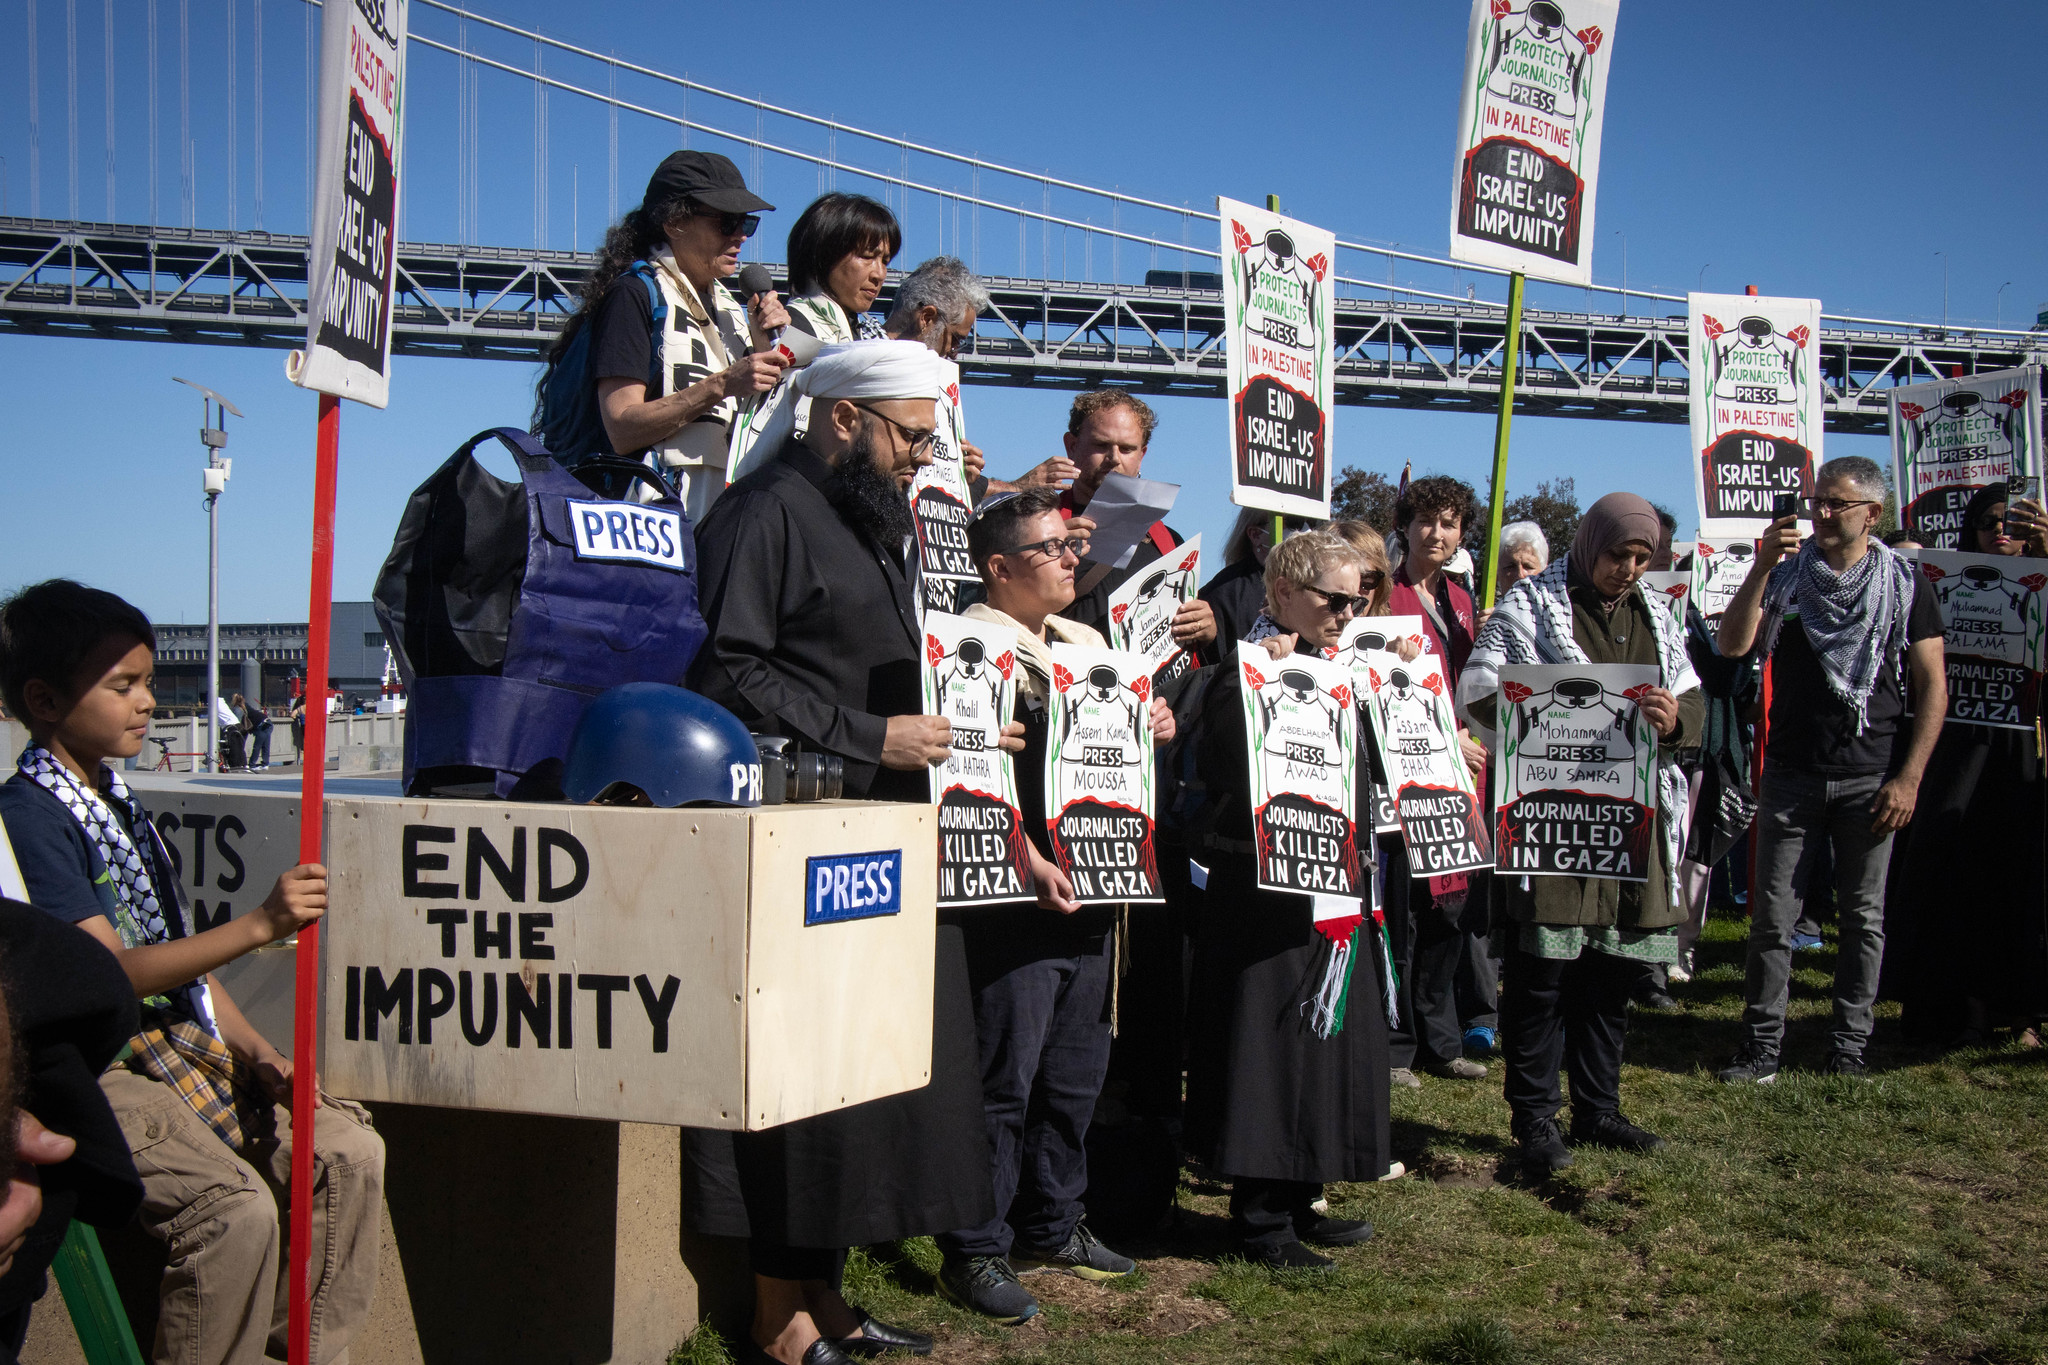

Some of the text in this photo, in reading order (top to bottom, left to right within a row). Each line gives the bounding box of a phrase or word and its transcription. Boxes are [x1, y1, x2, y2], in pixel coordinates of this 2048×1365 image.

[1513, 38, 1565, 69] PROTECT
[350, 24, 394, 117] PALESTINE
[1501, 58, 1570, 94] JOURNALISTS
[1510, 85, 1554, 113] PRESS
[1486, 105, 1571, 149] IN PALESTINE
[349, 120, 375, 196] END
[1506, 149, 1544, 183] END
[1476, 172, 1567, 221] ISRAEL-US
[337, 194, 387, 280] RAEL-US
[1474, 203, 1565, 252] IMPUNITY
[1259, 270, 1299, 301] PROTECT
[324, 265, 383, 349] MPUNITY
[1252, 293, 1308, 325] JOURNALISTS
[1264, 319, 1297, 346] PRESS
[1248, 344, 1312, 381] IN PALESTINE
[1732, 351, 1779, 368] PROTECT
[1723, 368, 1789, 385] JOURNALISTS
[1268, 388, 1295, 421] END
[1736, 387, 1777, 403] PRESS
[1718, 408, 1796, 428] IN PALESTINE
[1936, 417, 1990, 434] PROTECT
[1248, 416, 1314, 457] ISRAEL-US
[1925, 430, 2001, 449] JOURNALISTS
[1742, 440, 1775, 462] END
[1940, 447, 1987, 463] PRESS
[1249, 449, 1314, 489] IMPUNITY
[1717, 464, 1800, 488] ISRAEL-US
[1919, 462, 2011, 485] IN PALESTINE
[918, 498, 968, 525] JOURNALISTS
[1719, 489, 1801, 512] IMPUN
[1946, 490, 1977, 509] EN
[1918, 510, 1966, 532] ISRAE
[581, 510, 675, 559] PRESS
[925, 521, 969, 549] KILLED
[925, 547, 978, 575] IN GAZ
[1138, 605, 1162, 636] Jamal
[1954, 619, 2000, 634] PRESS
[1142, 617, 1169, 652] PRESS
[1943, 632, 2008, 653] SALAMA
[951, 682, 966, 693] NAME
[1949, 679, 2014, 701] ILLED
[955, 698, 978, 719] Khalil
[1083, 706, 1100, 716] NAME
[1281, 704, 1298, 714] NAME
[1955, 699, 2019, 723] GAZA
[1073, 722, 1102, 744] Assem
[1278, 725, 1331, 741] ABDELHALIM
[1394, 715, 1430, 734] Issam
[1539, 720, 1611, 742] Mohammad
[953, 728, 984, 750] PRESS
[1400, 740, 1430, 754] PRESS
[947, 755, 960, 775] ABU
[1083, 748, 1122, 766] PRESS
[1287, 743, 1324, 765] PRESS
[1548, 747, 1604, 761] PRESS
[1284, 762, 1328, 781] AWAD
[1400, 756, 1434, 777] BHAR
[1526, 764, 1621, 785] ABU SAMRA
[1073, 770, 1127, 791] MOUSSA
[940, 806, 1008, 830] JOURNALISTS
[1400, 795, 1466, 818] JOURNALISTS
[1513, 801, 1635, 824] JOURNALISTS
[1060, 817, 1143, 838] JOURNALISTS
[1266, 804, 1344, 837] JOURNALISTS
[1407, 817, 1465, 843] KILLED
[1275, 829, 1340, 863] KILLED
[1525, 823, 1623, 847] KILLED
[945, 833, 1006, 863] KILLED
[1072, 842, 1138, 867] KILLED
[1409, 841, 1482, 870] IN GAZA
[402, 824, 589, 903] END
[1513, 847, 1632, 874] IN GAZA
[816, 859, 893, 913] PRESS
[941, 866, 1023, 897] IN GAZA
[1071, 870, 1152, 896] IN GAZA
[1268, 857, 1350, 893] IN GAZA
[427, 909, 556, 960] THE
[344, 966, 681, 1053] IMPUNITY
